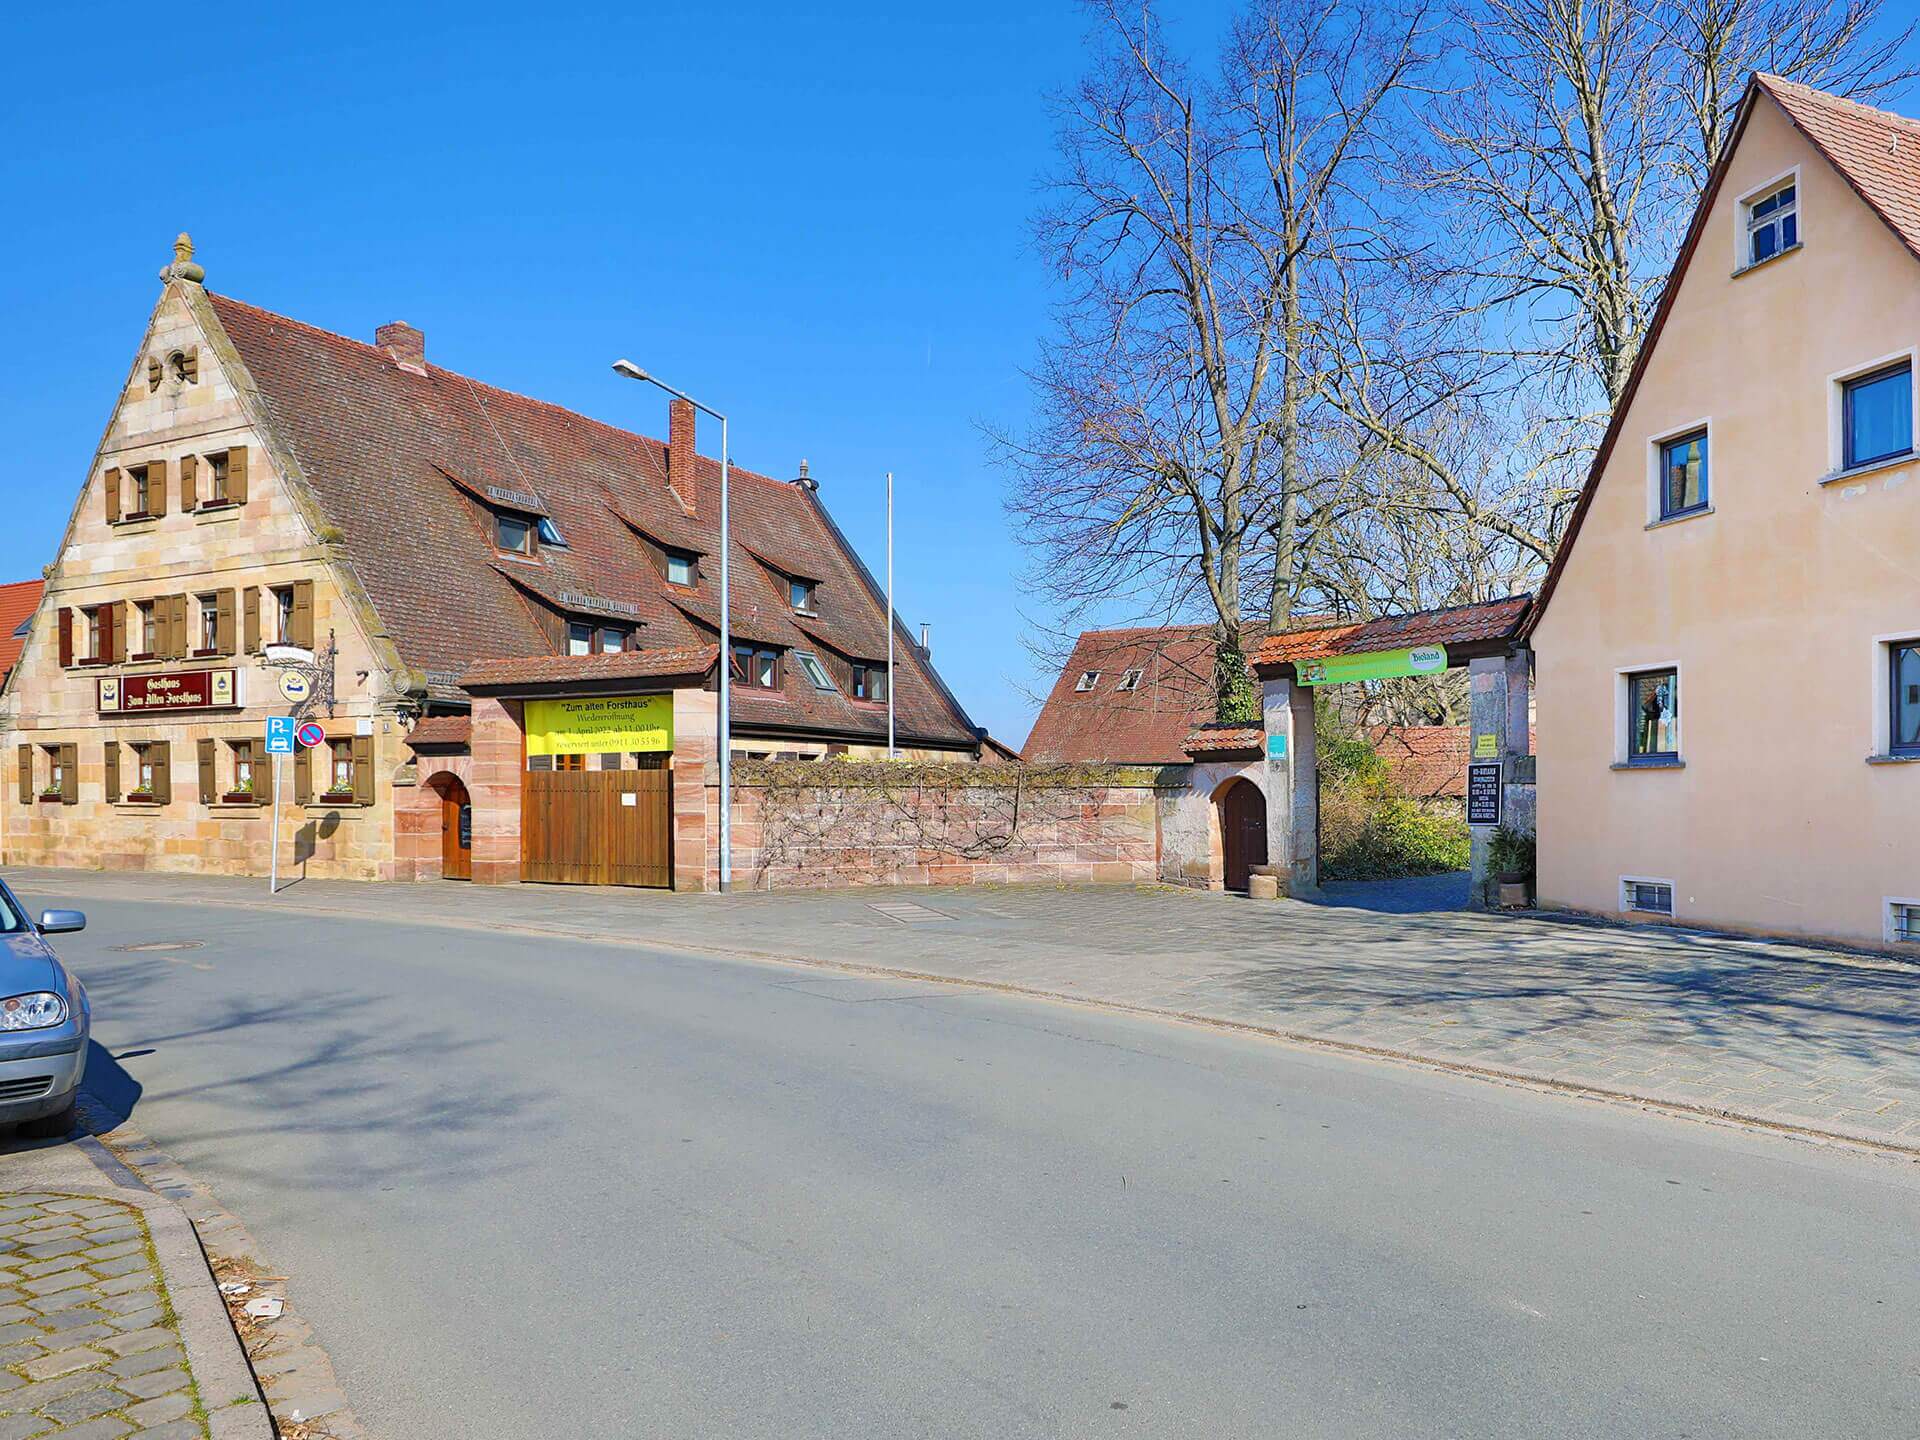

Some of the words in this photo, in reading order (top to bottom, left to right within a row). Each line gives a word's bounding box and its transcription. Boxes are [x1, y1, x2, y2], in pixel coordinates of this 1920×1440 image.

[1412, 651, 1440, 662] Bioland
[561, 703, 583, 712] "Zum
[585, 702, 604, 711] alten
[607, 699, 652, 710] Forsthaus"
[271, 719, 283, 734] P
